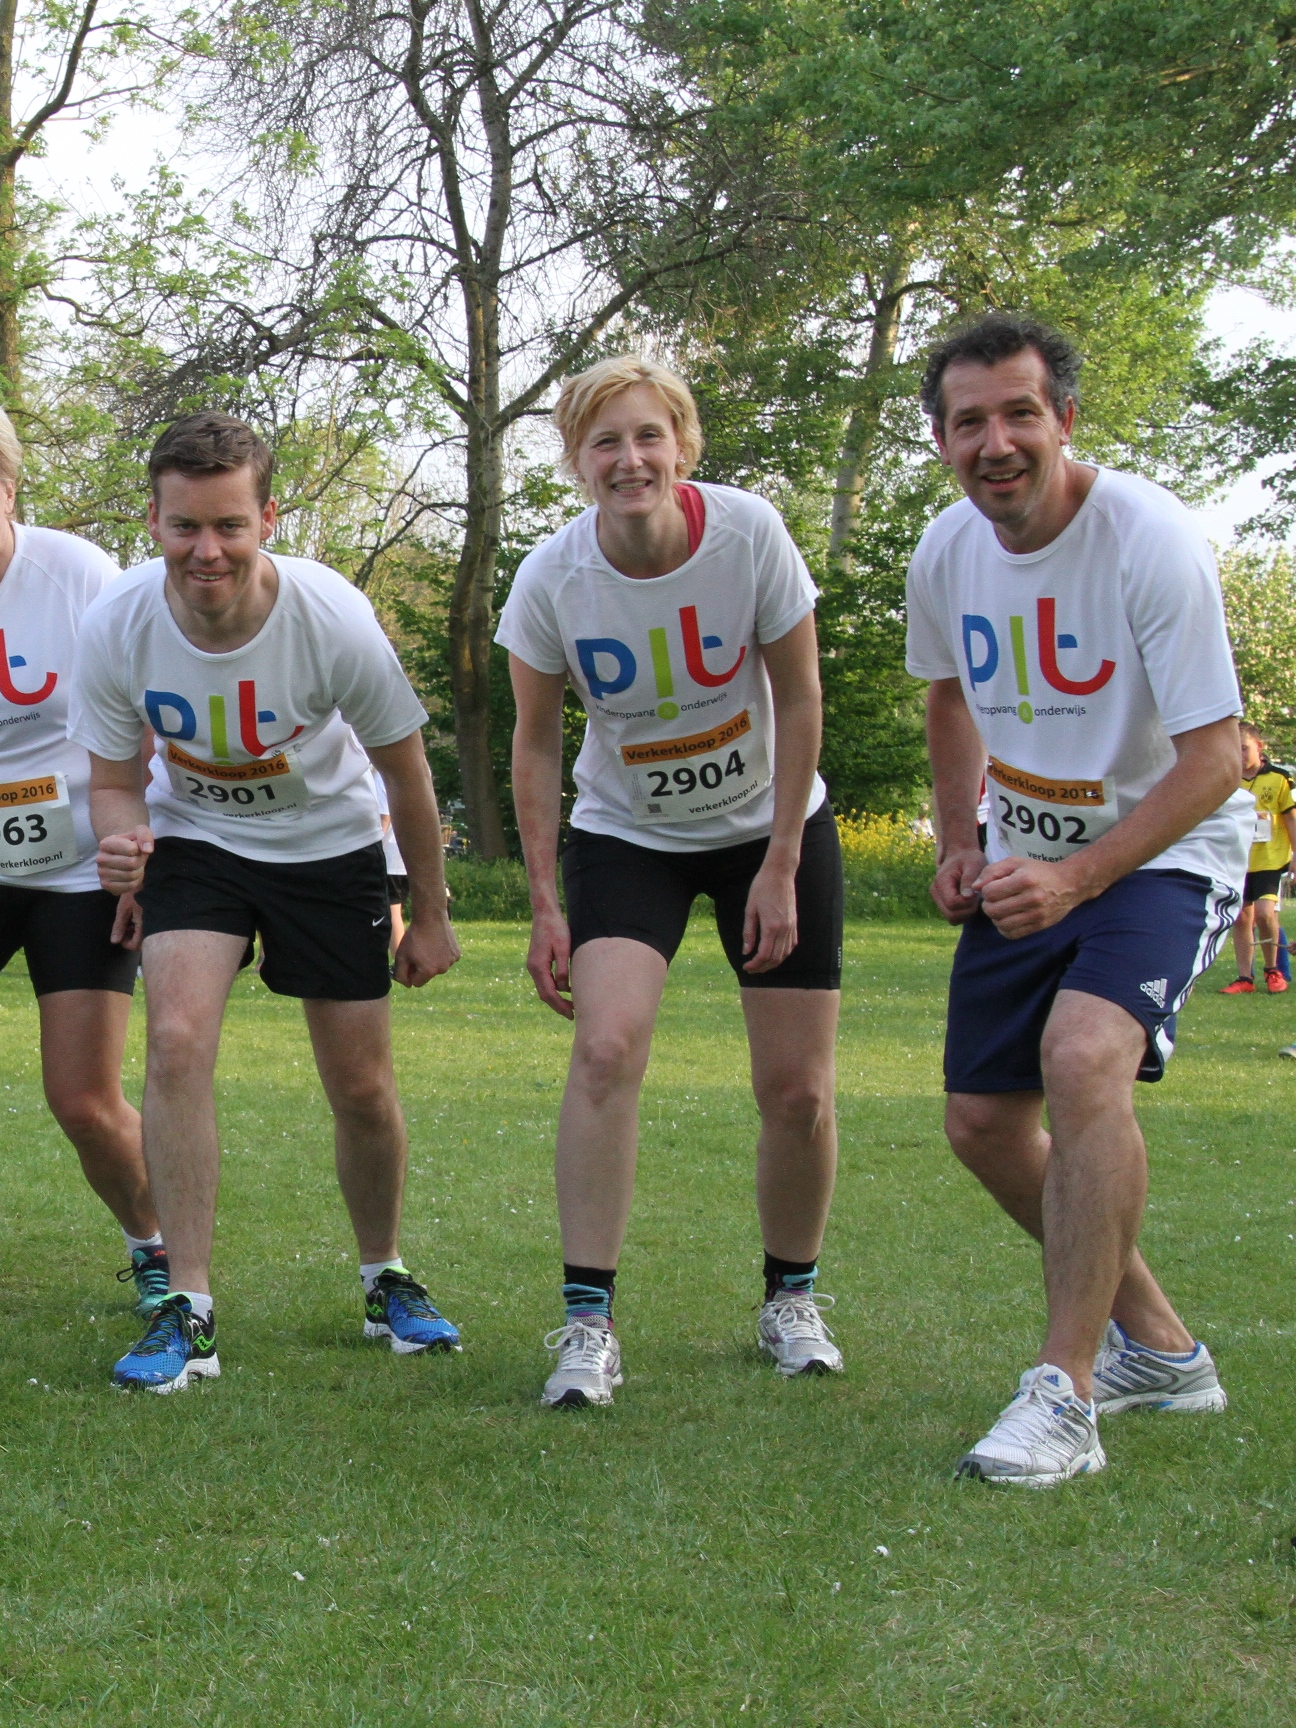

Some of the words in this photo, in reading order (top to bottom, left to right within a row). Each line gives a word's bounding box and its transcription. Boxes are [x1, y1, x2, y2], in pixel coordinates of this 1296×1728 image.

[680, 692, 728, 711] onderwijs
[1034, 704, 1087, 717] onderwijs
[626, 737, 717, 761] Verkerkloop
[719, 717, 749, 743] 2016
[170, 749, 247, 778] Verkerkloop
[250, 759, 286, 777] 2016
[647, 749, 746, 797] 2904
[21, 783, 54, 799] 2016
[185, 776, 276, 805] 2901
[689, 779, 759, 814] verkerkloop.nl
[1059, 786, 1101, 800] 2016
[222, 802, 298, 819] verkerkloop.nl
[998, 794, 1090, 844] 2902
